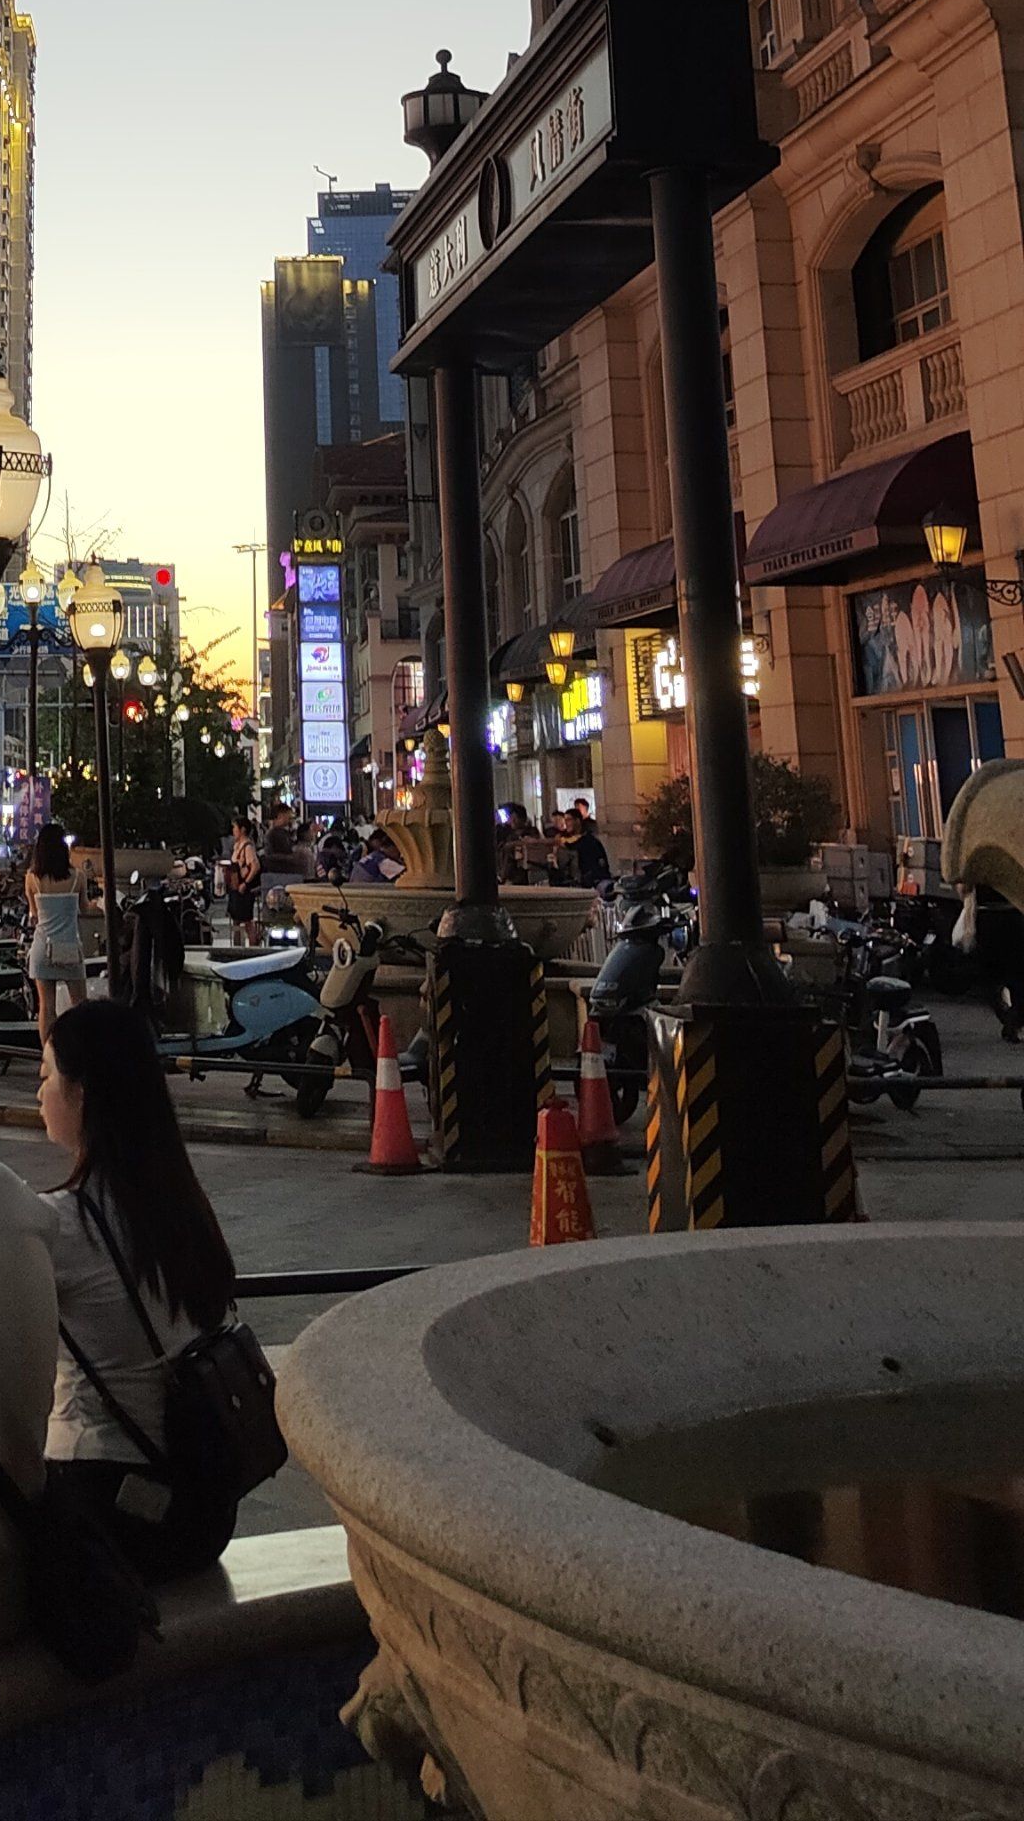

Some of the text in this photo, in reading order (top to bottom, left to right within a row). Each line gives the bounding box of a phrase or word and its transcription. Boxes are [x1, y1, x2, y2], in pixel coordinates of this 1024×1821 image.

[428, 85, 585, 299] 意大利 风情街
